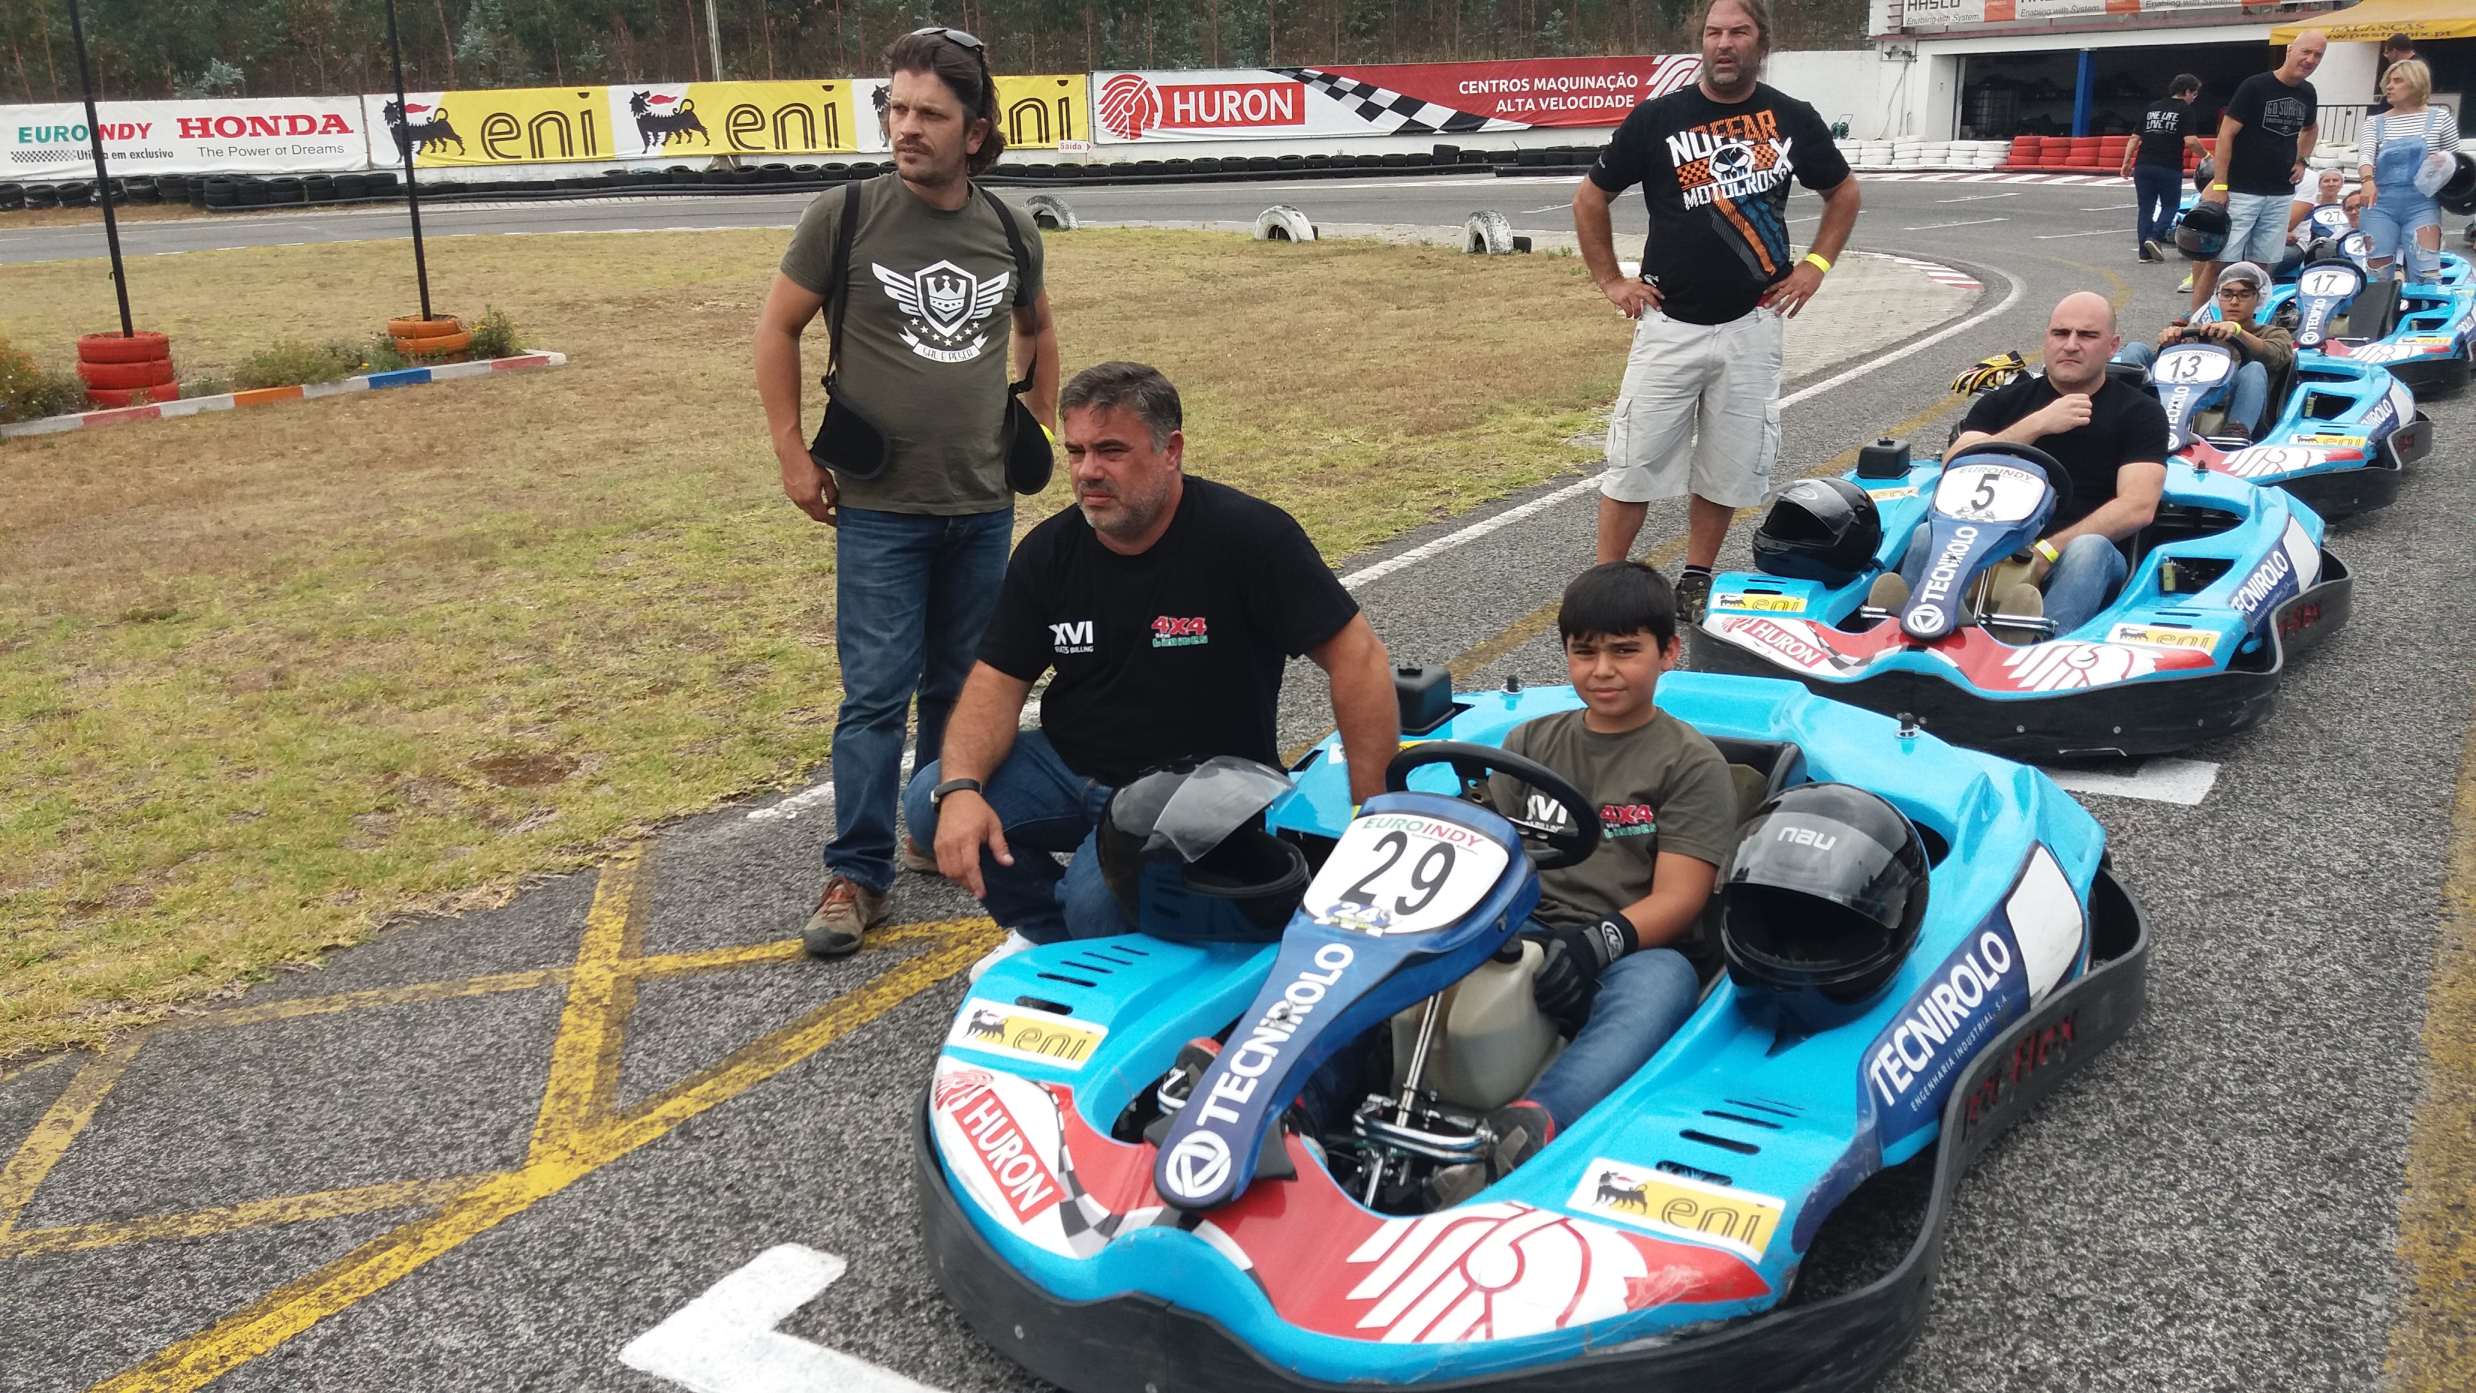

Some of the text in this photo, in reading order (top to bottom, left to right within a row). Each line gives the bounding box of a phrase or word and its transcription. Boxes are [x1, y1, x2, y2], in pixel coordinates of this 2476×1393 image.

[1459, 71, 1638, 95] CENTROS MAQUINAÇÃO
[726, 84, 839, 151] eni
[1000, 79, 1072, 144] ni
[1173, 88, 1293, 123] HURON
[1496, 94, 1635, 113] ALTA VELOCIDADE
[2146, 111, 2160, 120] ONE
[18, 113, 354, 144] EURONDY HONDA
[480, 91, 597, 160] eni
[2145, 120, 2163, 129] LIVE
[111, 151, 127, 160] em
[129, 147, 174, 159] exclusivo
[198, 146, 224, 158] The
[228, 147, 270, 156] Power
[292, 144, 345, 155] Dreams
[2324, 211, 2341, 222] 27
[2313, 274, 2338, 292] 17
[2169, 354, 2202, 379] 13
[1970, 474, 2001, 511] 5
[1049, 620, 1093, 646] XVI
[1752, 621, 1822, 666] HURON
[2156, 633, 2211, 649] eni
[1363, 817, 1484, 848] EUROINDY
[1777, 826, 1837, 851] nau
[1338, 830, 1456, 916] 29
[1869, 931, 2011, 1108] TECNIROLO
[1012, 1026, 1093, 1061] eni
[963, 1097, 1054, 1212] HURON
[1661, 1197, 1767, 1246] eni
